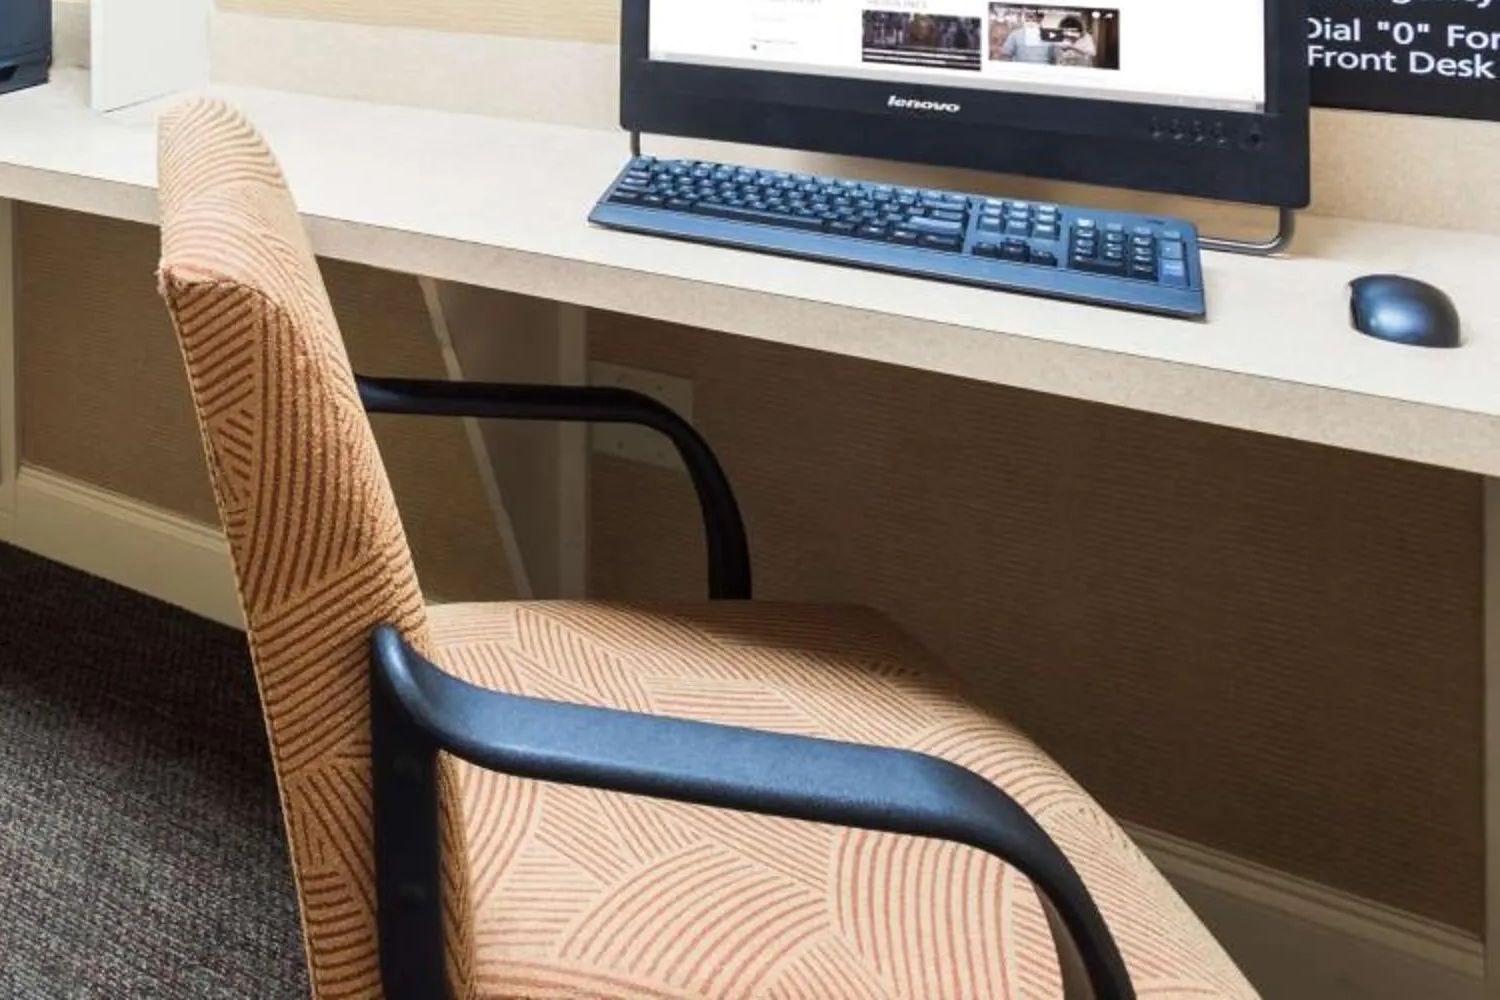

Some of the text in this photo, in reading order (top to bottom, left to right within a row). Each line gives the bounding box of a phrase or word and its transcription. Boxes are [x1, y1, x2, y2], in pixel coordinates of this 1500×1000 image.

[1376, 20, 1431, 45] "0"
[1307, 45, 1496, 79] Front Desk
[887, 95, 960, 112] lenovo
